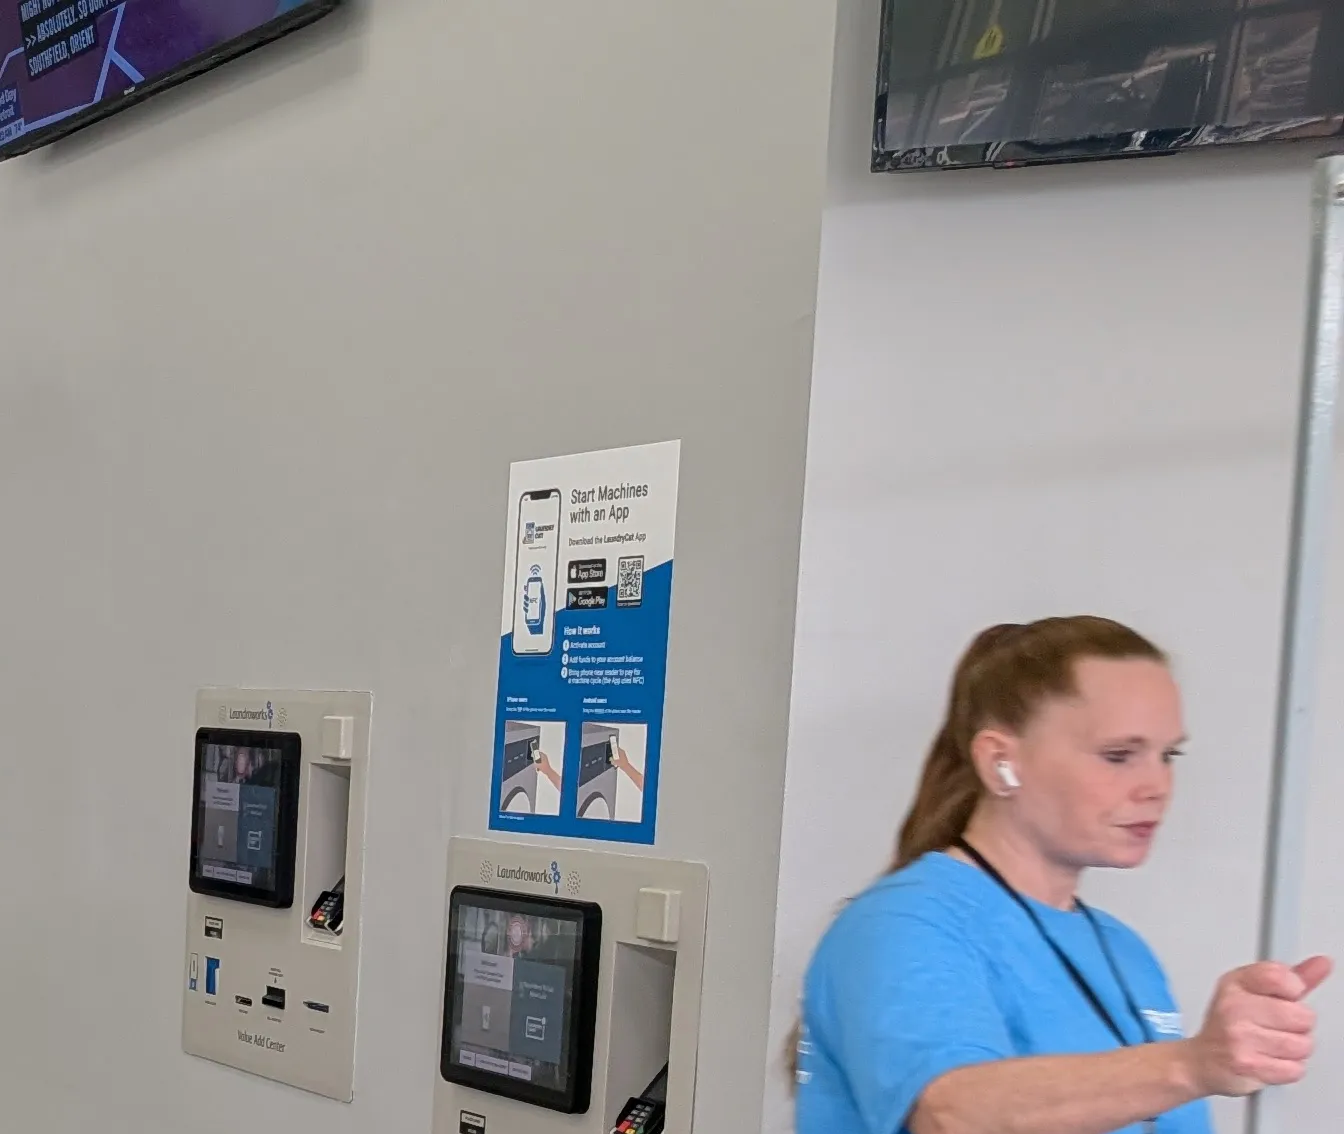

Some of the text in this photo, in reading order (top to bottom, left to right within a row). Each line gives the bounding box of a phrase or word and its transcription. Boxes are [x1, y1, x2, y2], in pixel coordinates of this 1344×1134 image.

[37, 4, 78, 42] ABSOLUTELY.
[28, 25, 95, 77] SOUTHFIELD, ORIENT
[571, 483, 648, 504] Start Machines
[570, 505, 629, 523] with an App
[230, 708, 267, 720] Laundroworks
[497, 865, 552, 884] Laundroworks
[237, 1029, 286, 1052] Value Add Center
